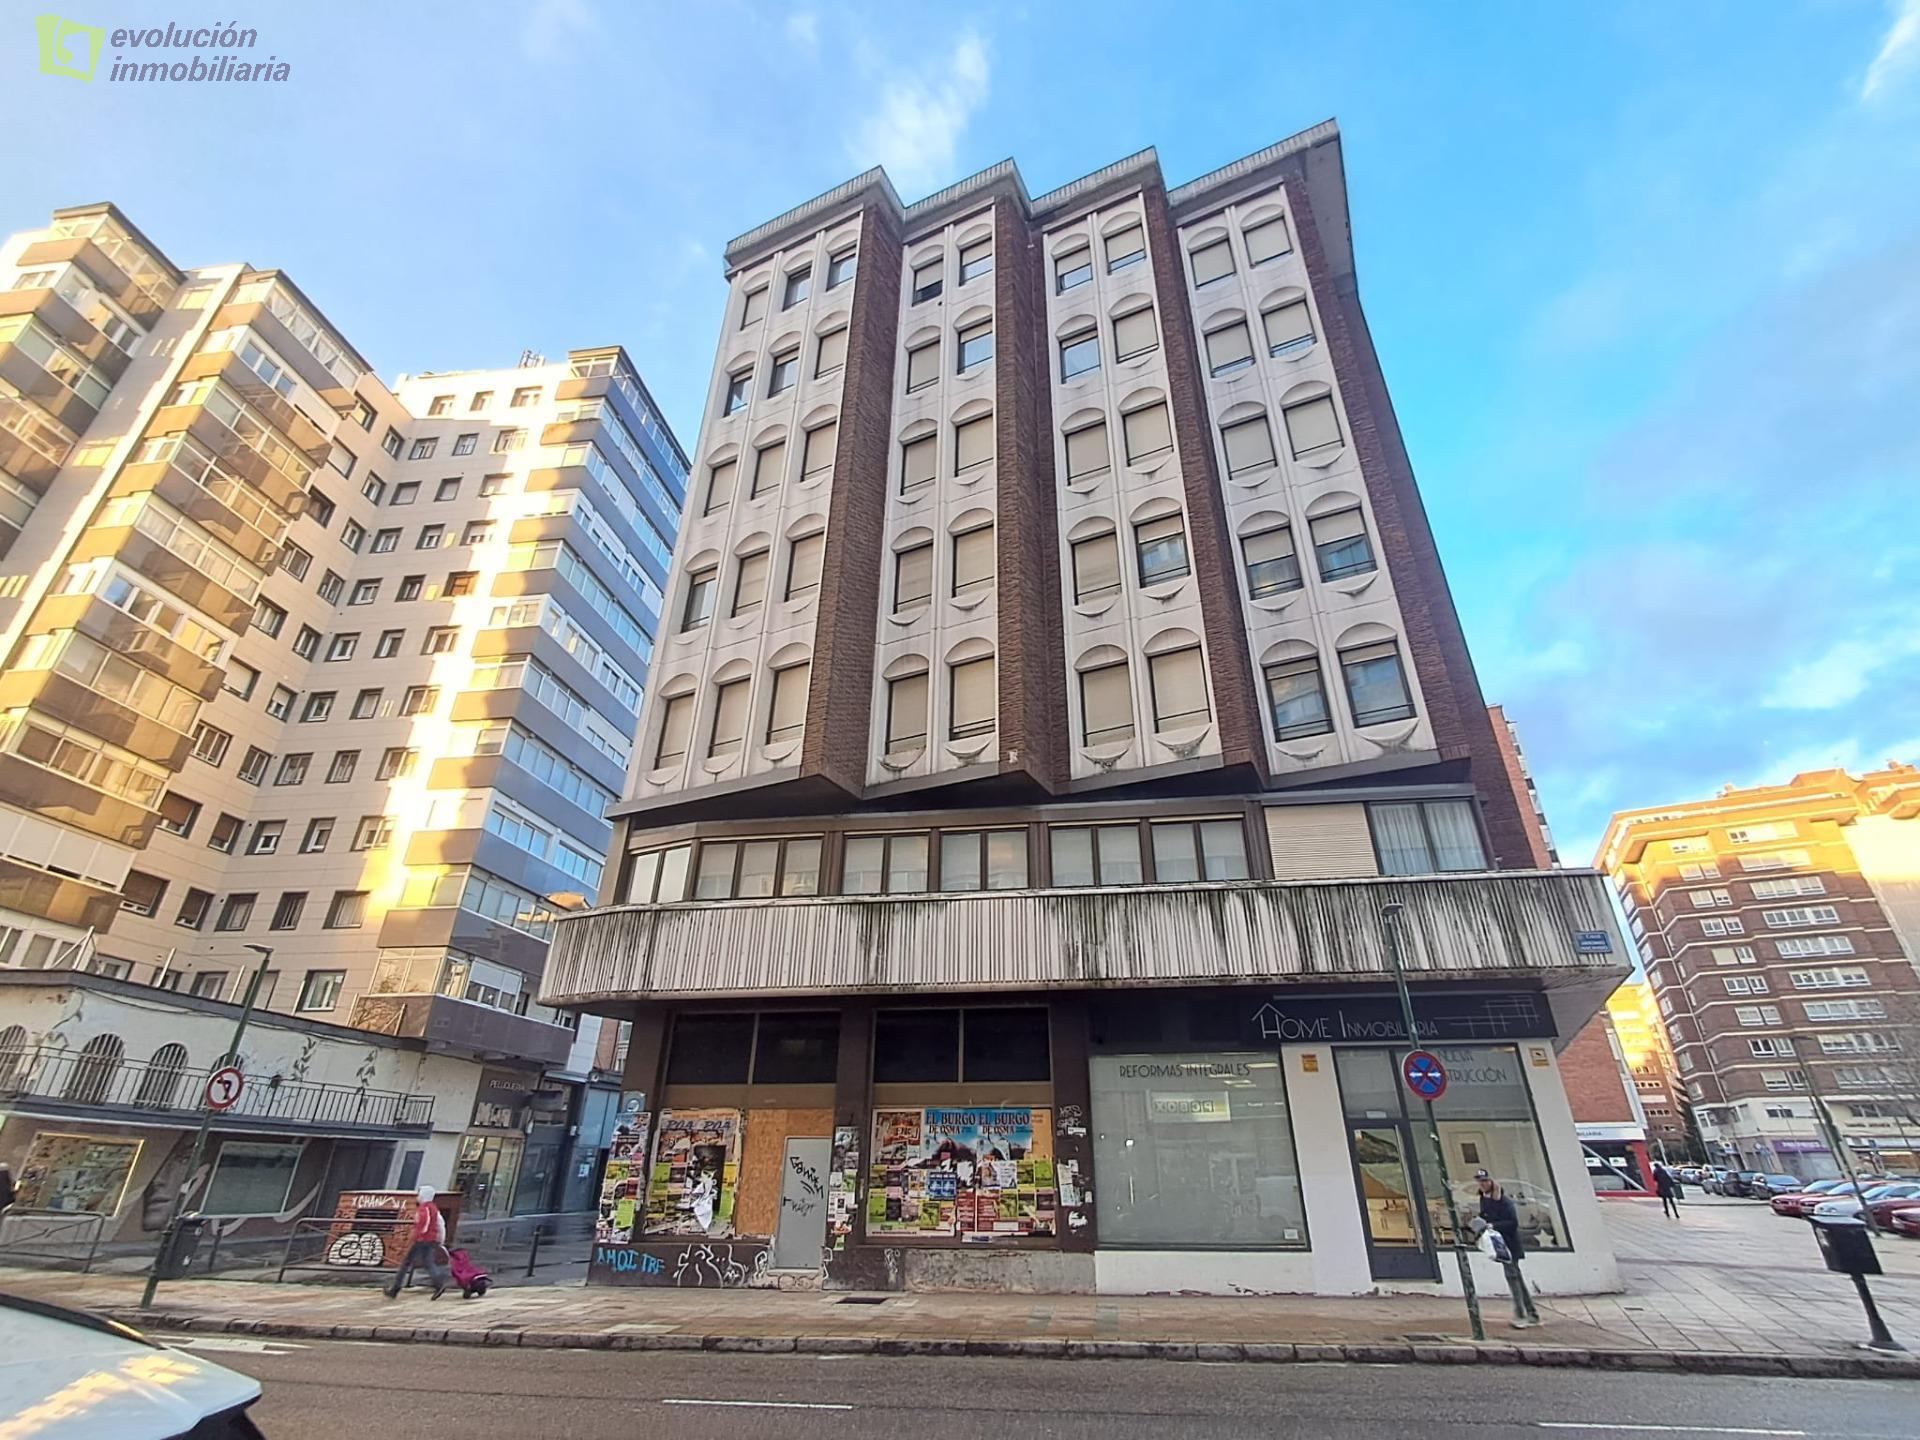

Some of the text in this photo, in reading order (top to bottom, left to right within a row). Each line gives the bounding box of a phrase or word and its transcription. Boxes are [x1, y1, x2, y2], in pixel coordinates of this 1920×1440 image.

[1339, 1010, 1440, 1038] INMOBILRIA
[1119, 1062, 1250, 1078] REFORMAS INTEGRALES
[926, 1112, 976, 1125] EL BURGO
[979, 1112, 1030, 1125] EL BURGO
[929, 1125, 938, 1134] DE
[982, 1125, 992, 1134] DE
